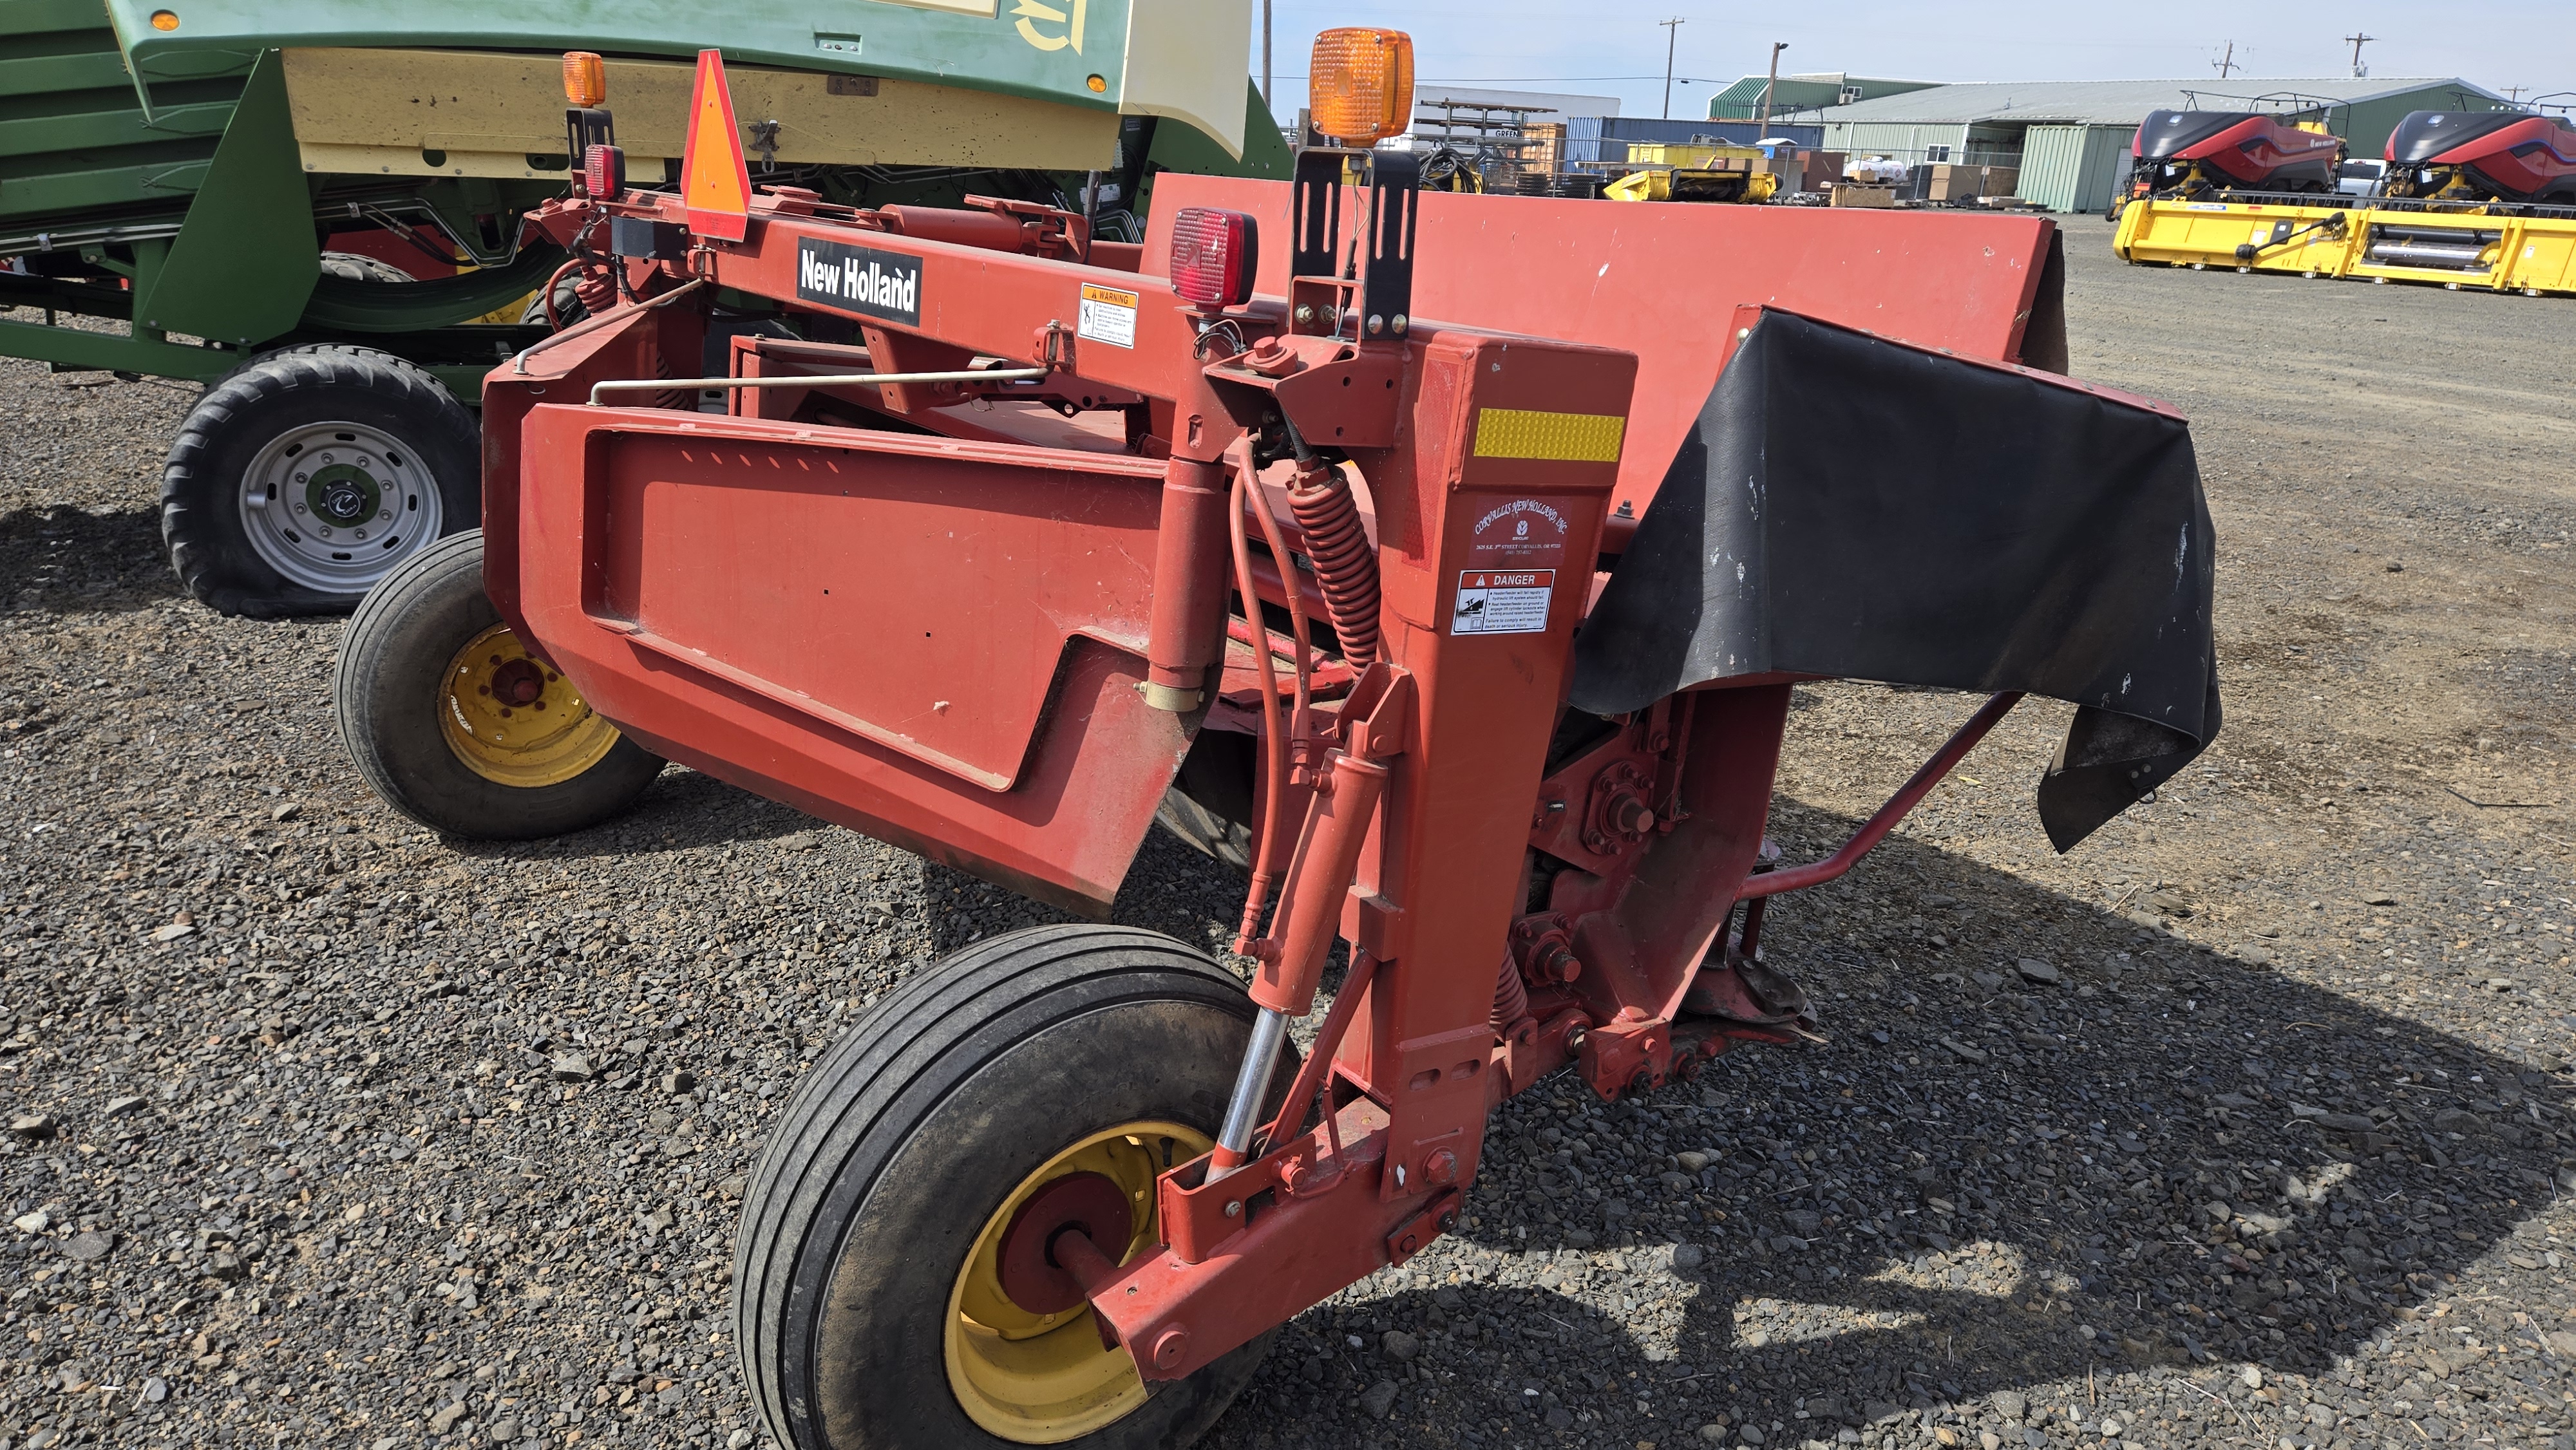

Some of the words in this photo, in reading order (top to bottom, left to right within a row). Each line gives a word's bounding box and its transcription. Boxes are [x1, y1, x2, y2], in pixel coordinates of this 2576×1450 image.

[801, 249, 840, 295] New
[844, 257, 916, 312] Holland
[1099, 290, 1129, 305] WARNING
[1475, 503, 1511, 535] CORVALLIS
[1511, 498, 1529, 514] NEW
[1528, 499, 1557, 523] HOLLAND,
[1493, 575, 1535, 585] DANGER
